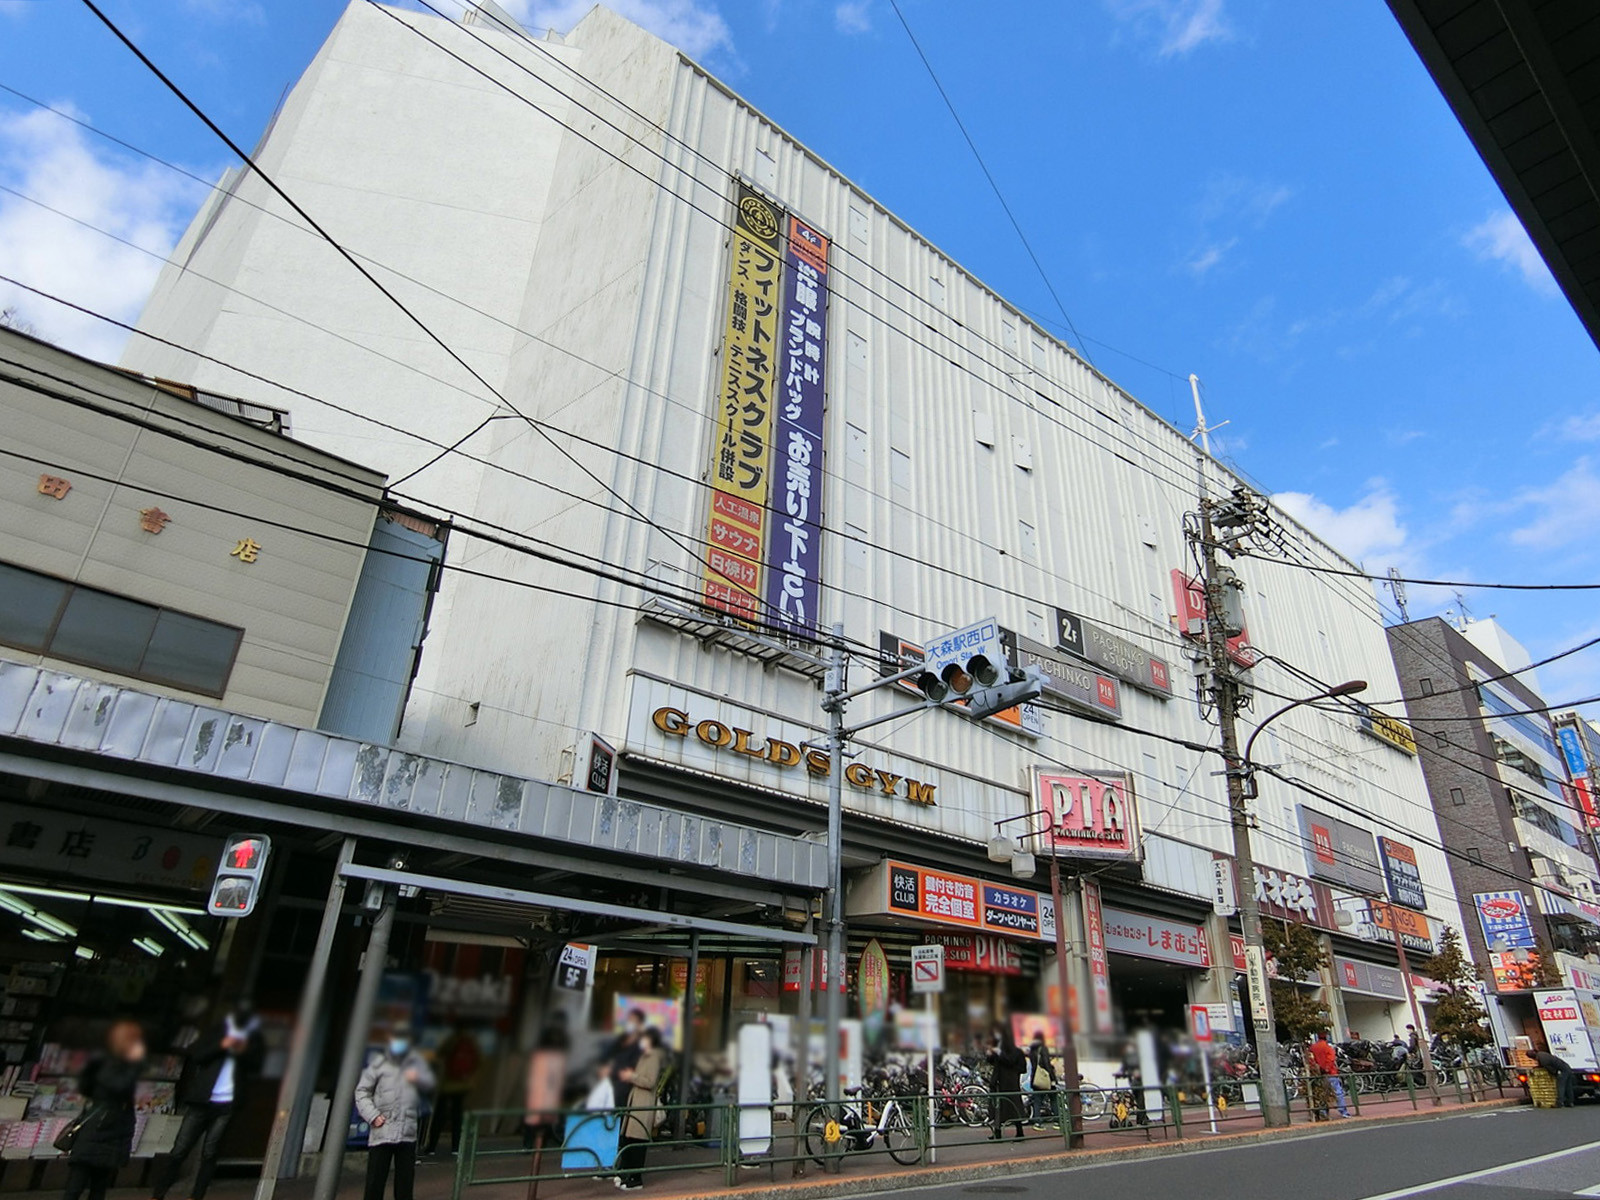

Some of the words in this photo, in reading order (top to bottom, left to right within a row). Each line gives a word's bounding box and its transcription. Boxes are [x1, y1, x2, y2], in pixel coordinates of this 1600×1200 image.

[738, 248, 775, 490] フィットネスクラブ
[715, 496, 760, 526] 人工温泉
[712, 524, 758, 551] サウナ
[778, 431, 813, 628] お売り下さい
[710, 554, 756, 584] 日焼け
[928, 623, 995, 662] 大森駅西口
[1061, 617, 1078, 644] 2F
[1092, 631, 1145, 666] PACHINKO
[1027, 653, 1092, 691] PACHINKO
[1152, 665, 1166, 681] PIA
[1099, 684, 1114, 699] PIA
[652, 706, 832, 777] GOLD'S
[845, 762, 939, 807] GYM
[1049, 780, 1125, 831] PIA
[7, 820, 96, 858] 書店
[893, 873, 916, 891] 快活
[894, 890, 916, 904] CLUB
[925, 892, 976, 920] 完全個室
[993, 891, 1027, 909] カラオケ
[986, 909, 1037, 930] ダーツ・ビリヤード
[1042, 918, 1055, 929] OPE
[1387, 907, 1416, 927] BNGO
[924, 934, 972, 946] PACHINKO
[975, 934, 1008, 968] PIA
[1147, 925, 1199, 955] しまむら
[575, 954, 587, 966] OPEN
[949, 950, 972, 961] SLOT
[565, 967, 581, 986] 5F
[1542, 1009, 1575, 1020] 食材卸
